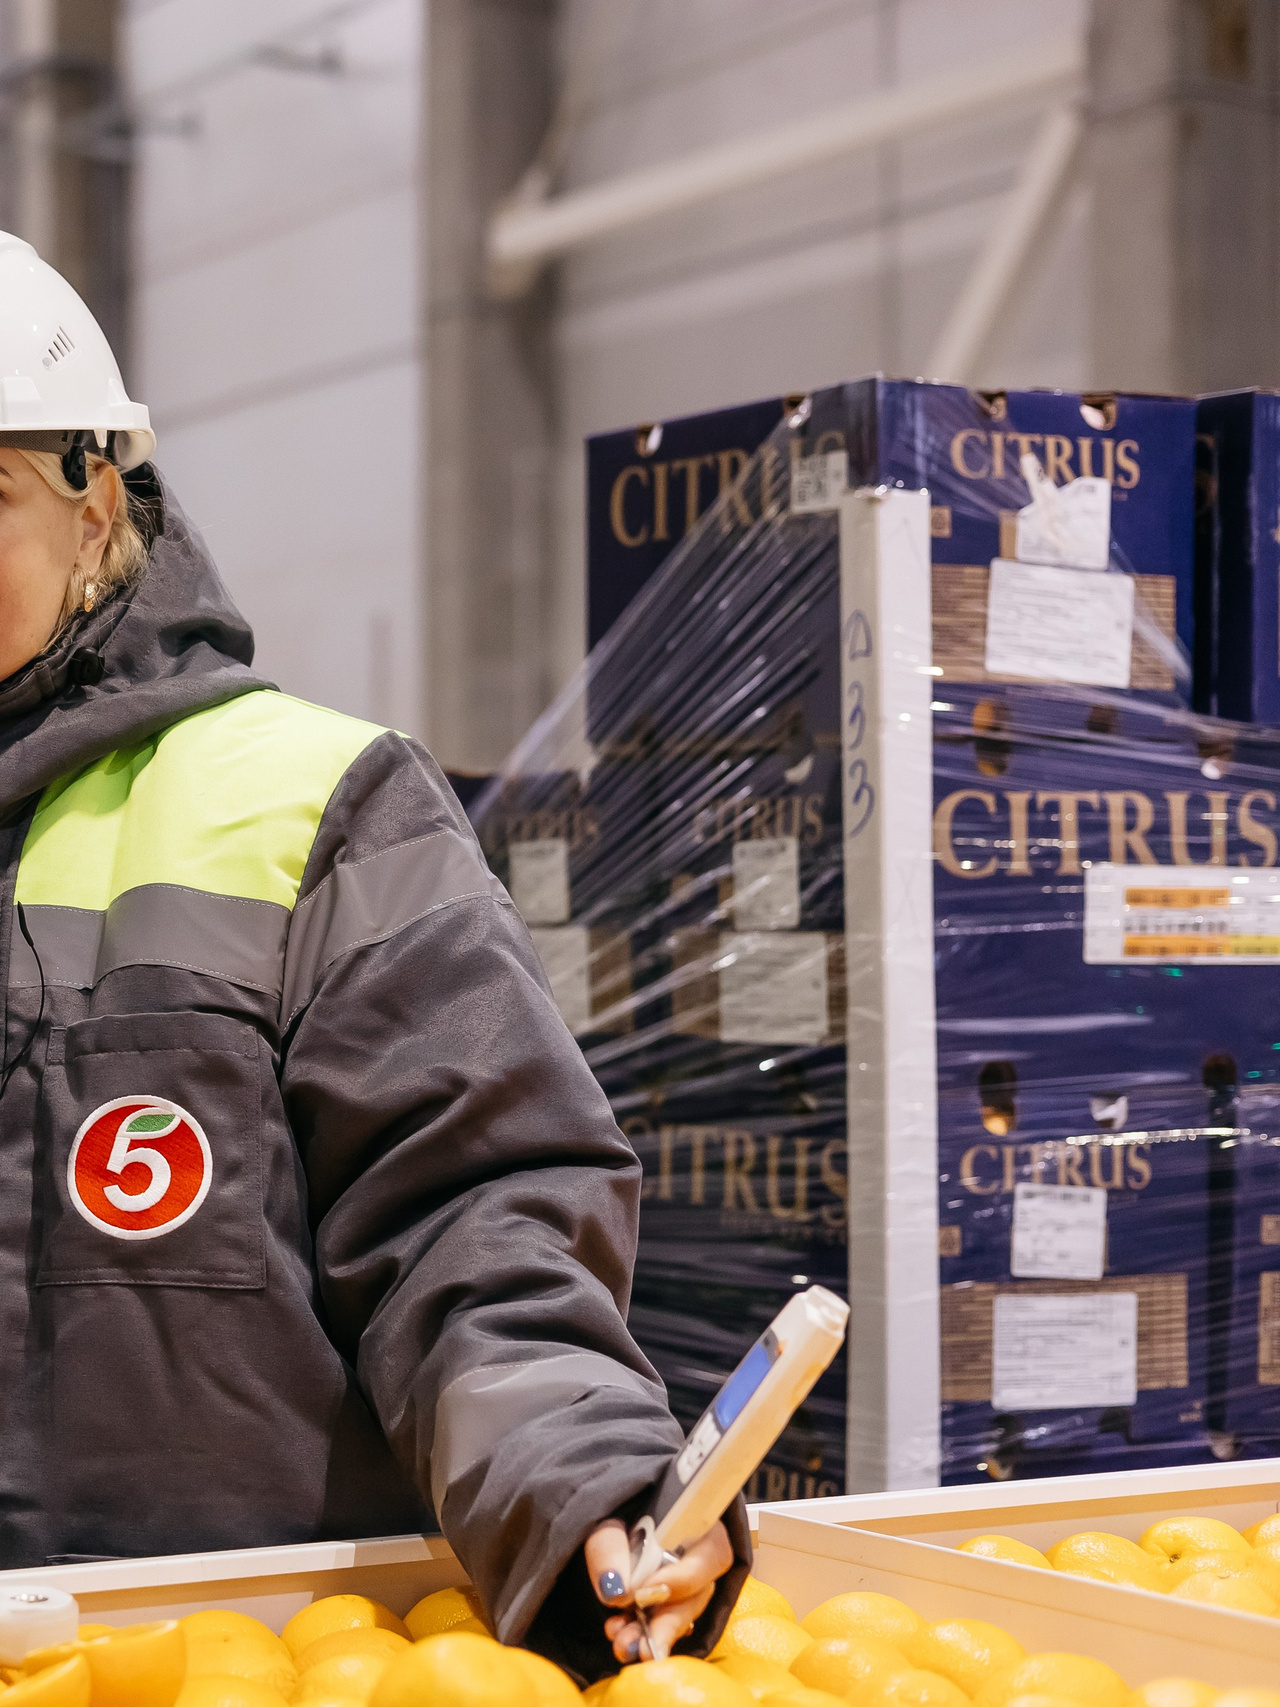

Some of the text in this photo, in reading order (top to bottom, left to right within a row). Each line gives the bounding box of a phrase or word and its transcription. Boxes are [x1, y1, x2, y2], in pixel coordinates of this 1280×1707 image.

[950, 427, 1141, 490] CITRUS
[931, 789, 1279, 879] CITRUS
[103, 1107, 182, 1212] 5
[959, 1142, 1153, 1195] CITRUS
